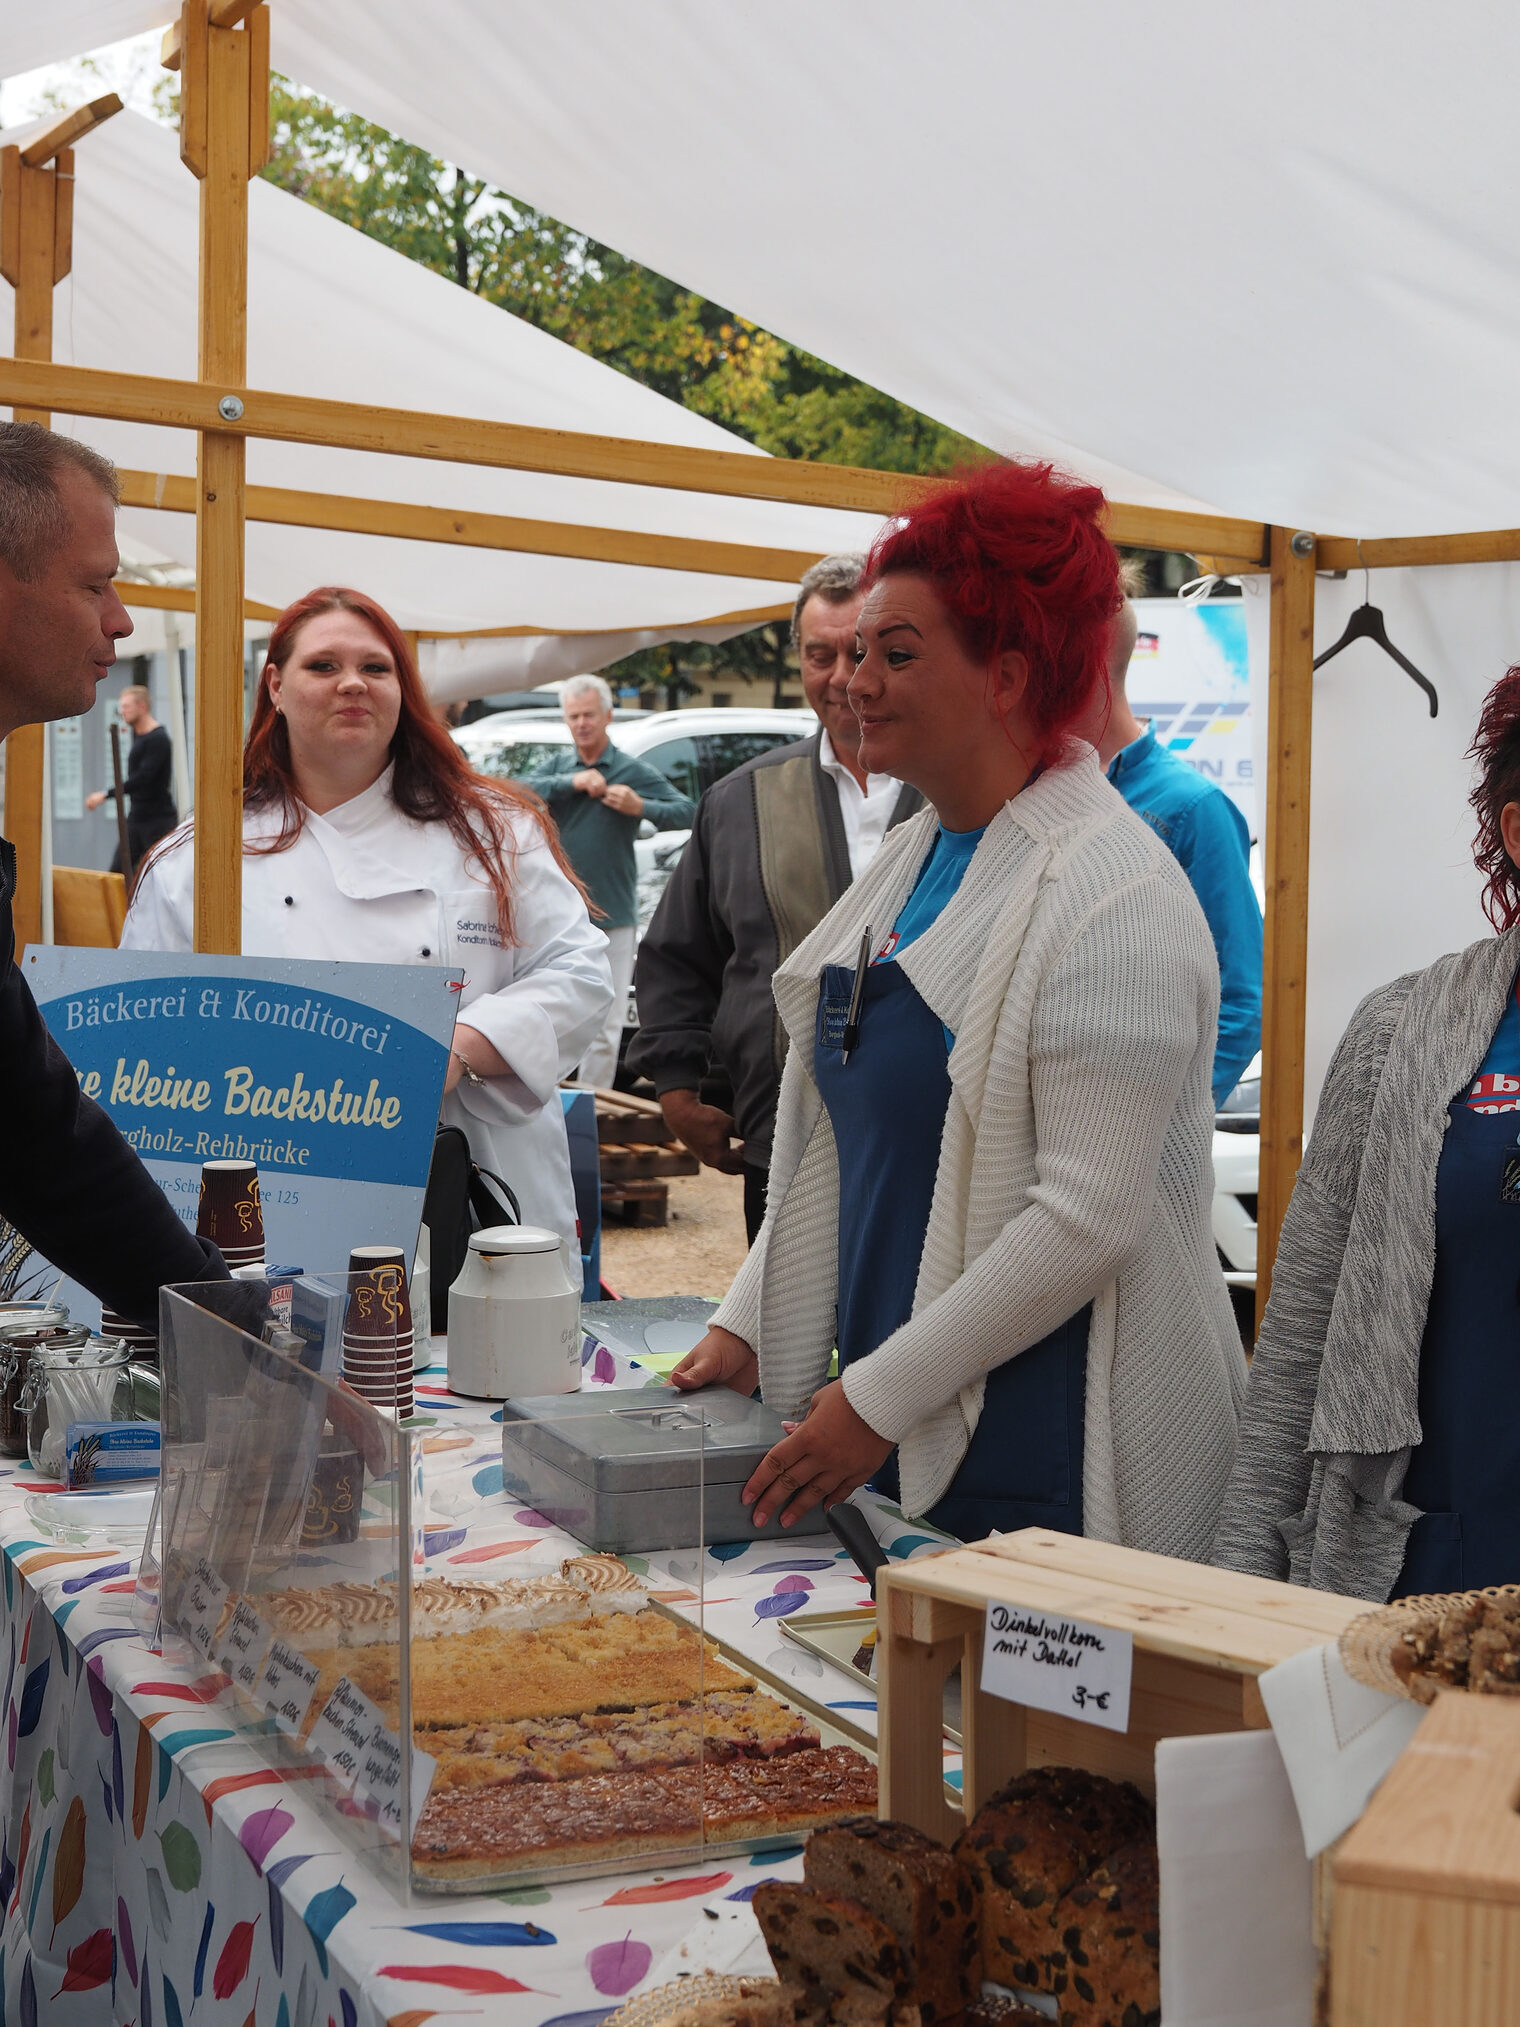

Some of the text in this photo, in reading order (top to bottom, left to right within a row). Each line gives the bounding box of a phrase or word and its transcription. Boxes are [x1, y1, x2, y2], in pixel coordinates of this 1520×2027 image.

[65, 987, 391, 1055] Bäckerei & Konditorei
[110, 1057, 212, 1112] kleine
[224, 1065, 402, 1130] Backstube
[277, 1189, 300, 1205] 125
[993, 1638, 1083, 1668] mit Dattel
